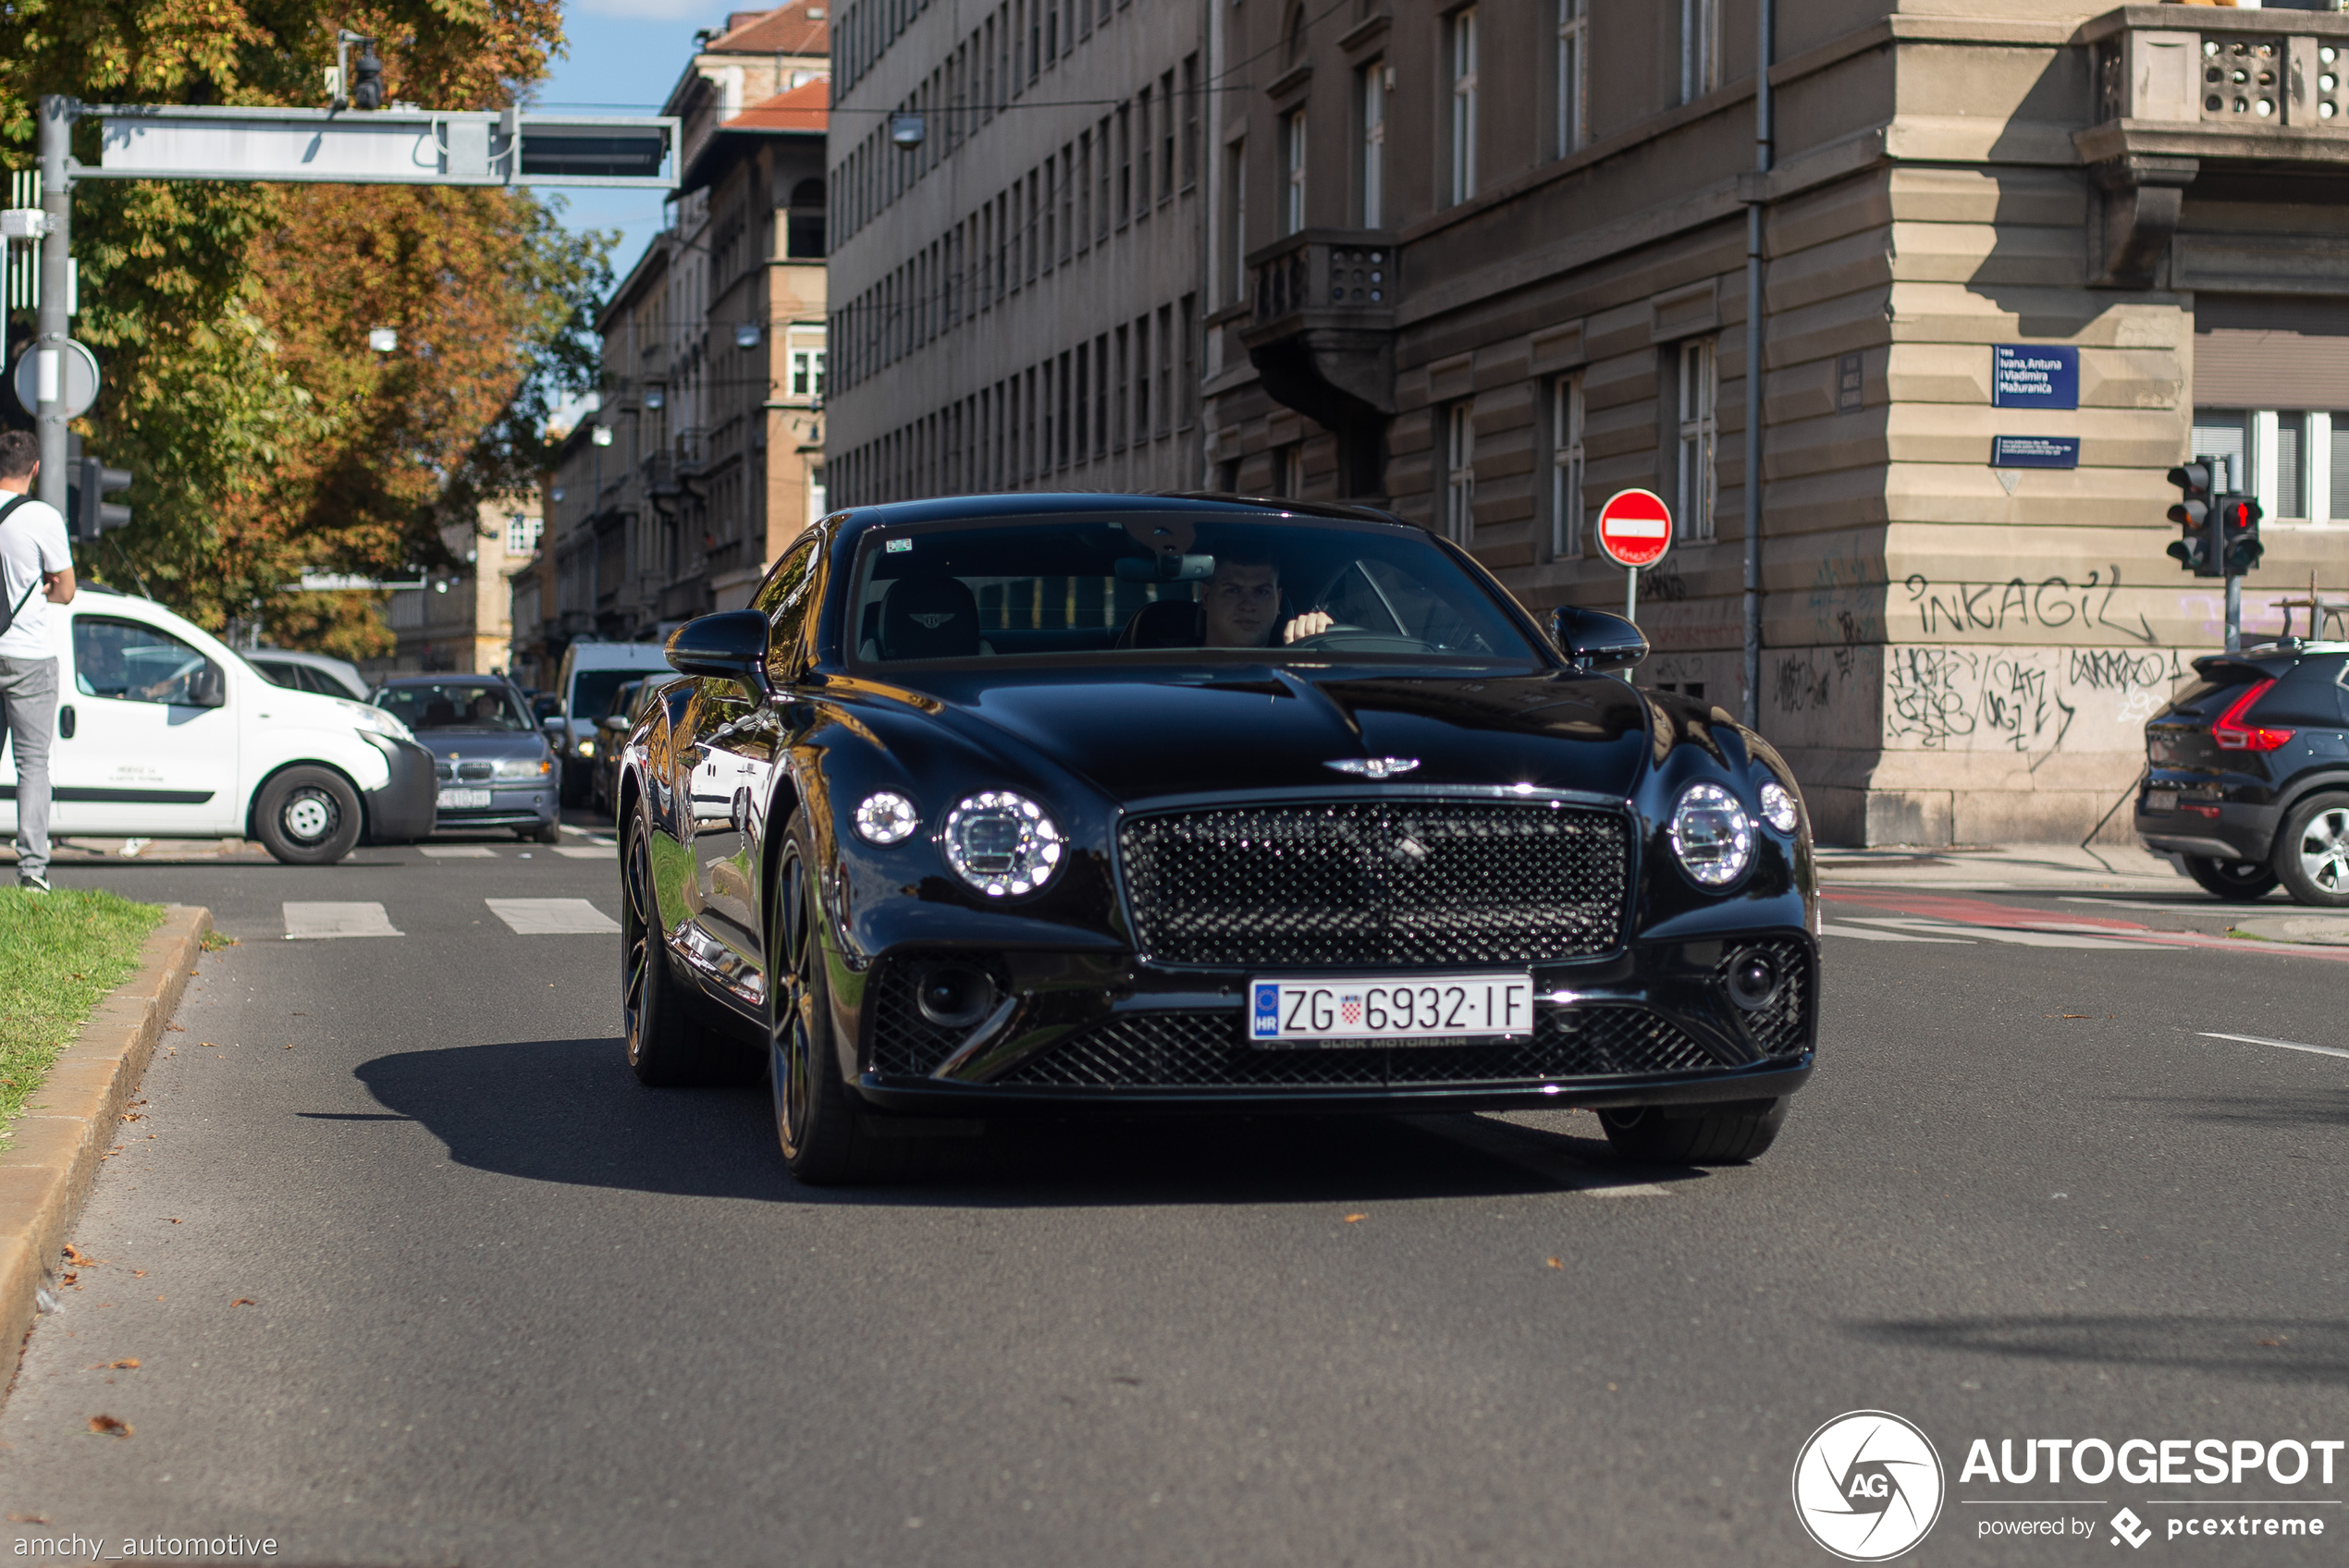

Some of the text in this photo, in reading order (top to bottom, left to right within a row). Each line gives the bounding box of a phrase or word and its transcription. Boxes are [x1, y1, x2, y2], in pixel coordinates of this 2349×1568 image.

[1999, 358, 2062, 371] Ivana, Antuna
[2004, 370, 2048, 383] Vladimira
[1285, 988, 1334, 1031] ZG
[1256, 1015, 1277, 1031] HR
[1319, 1038, 1367, 1049] CLICK
